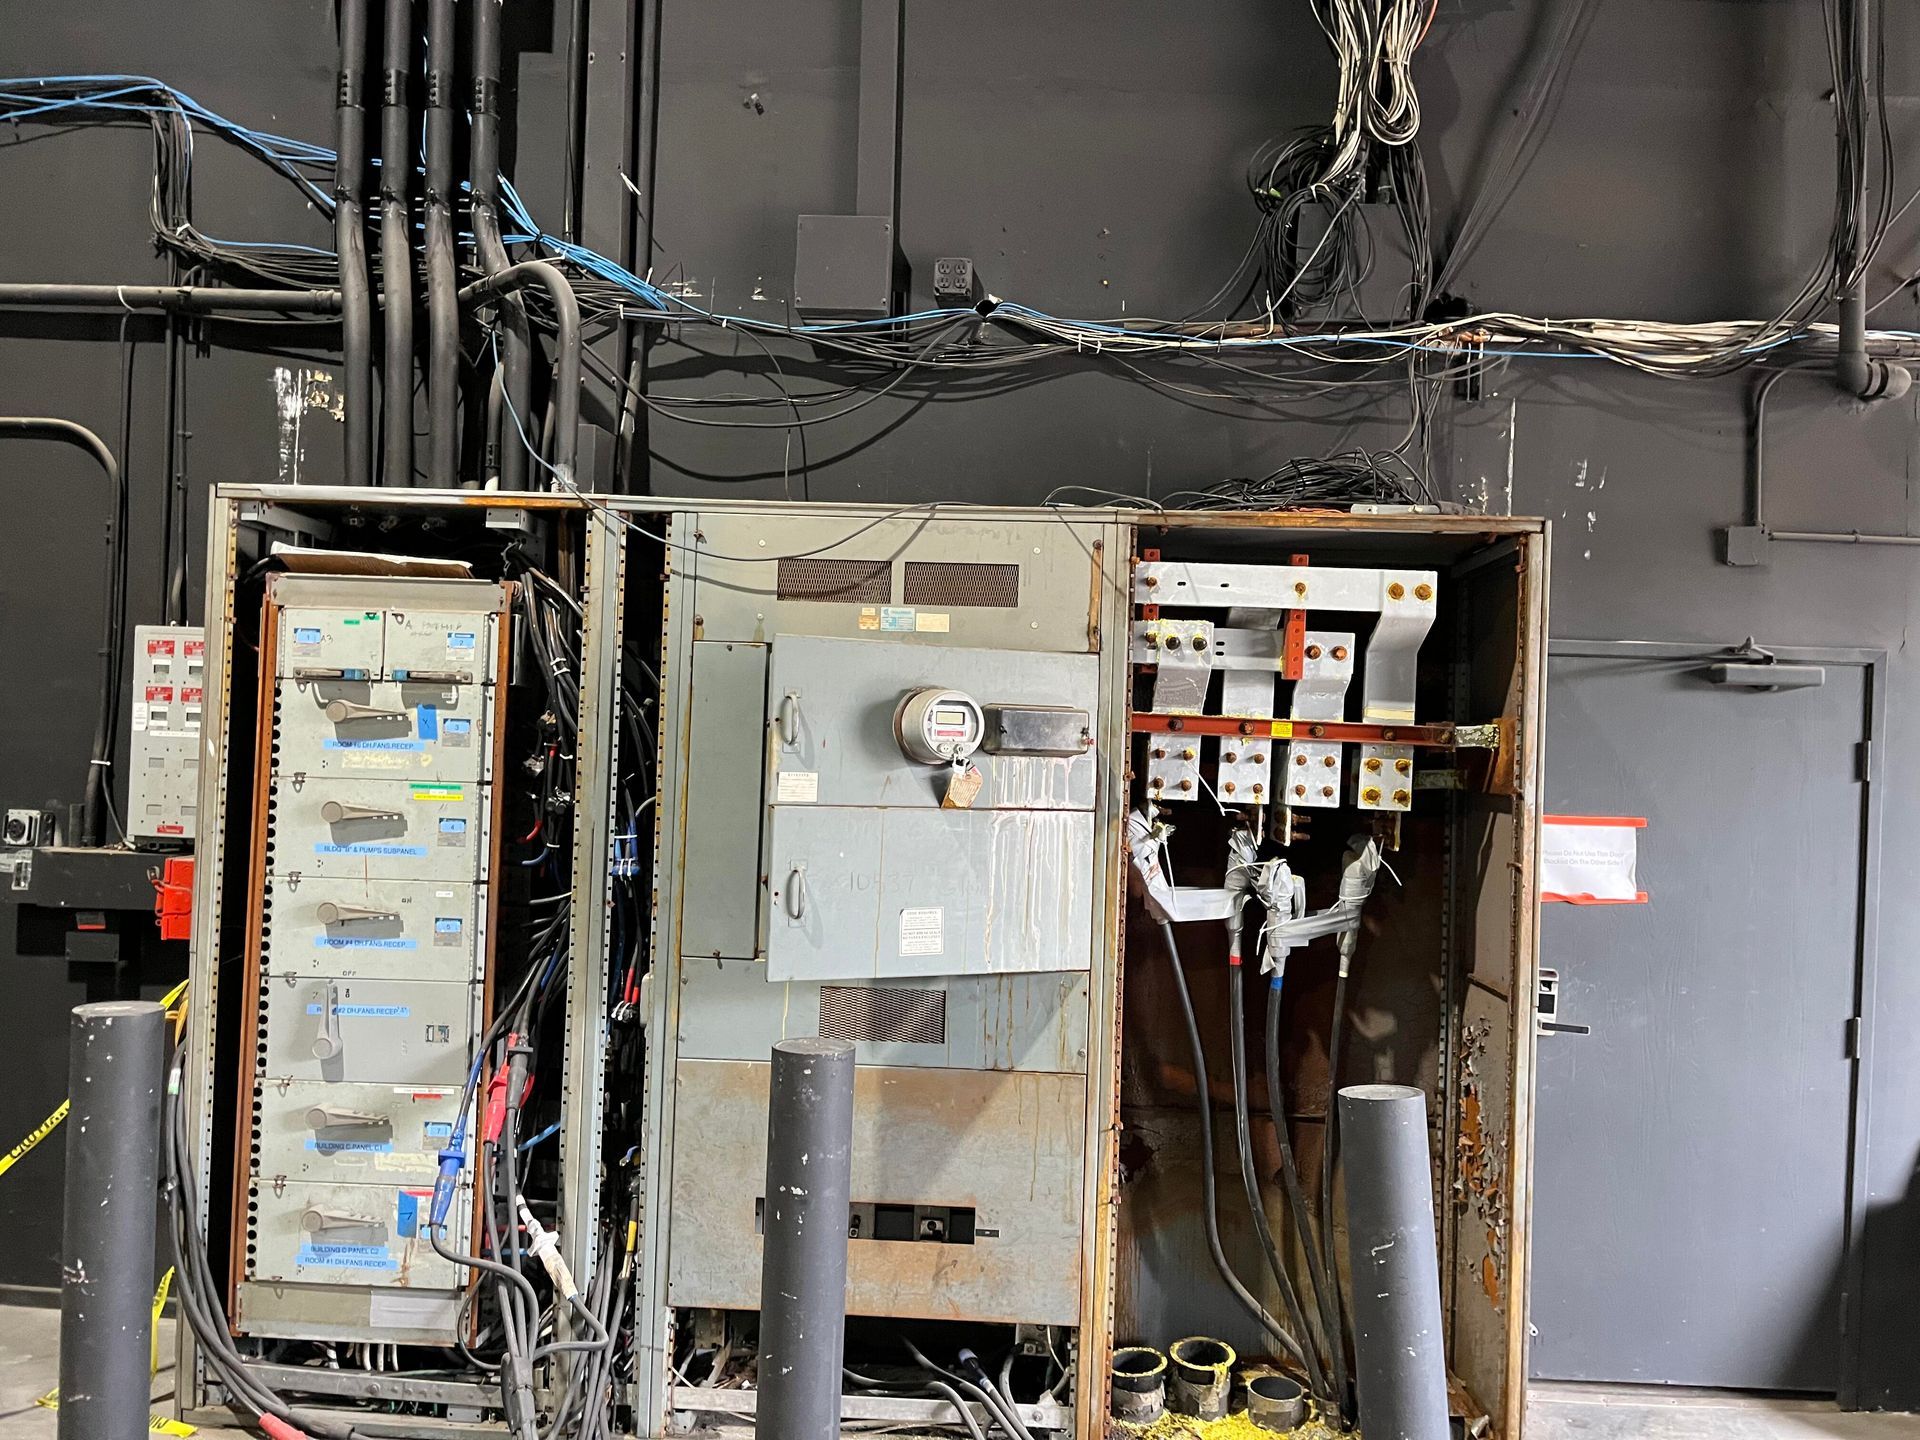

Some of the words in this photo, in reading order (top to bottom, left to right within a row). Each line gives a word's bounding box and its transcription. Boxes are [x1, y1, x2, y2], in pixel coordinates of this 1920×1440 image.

[358, 846, 382, 854] PUMPS
[383, 847, 417, 855] SUBPANEL
[315, 1142, 345, 1150] BUILDING
[311, 1245, 341, 1253] BUILDING
[305, 1257, 325, 1265] ROOM
